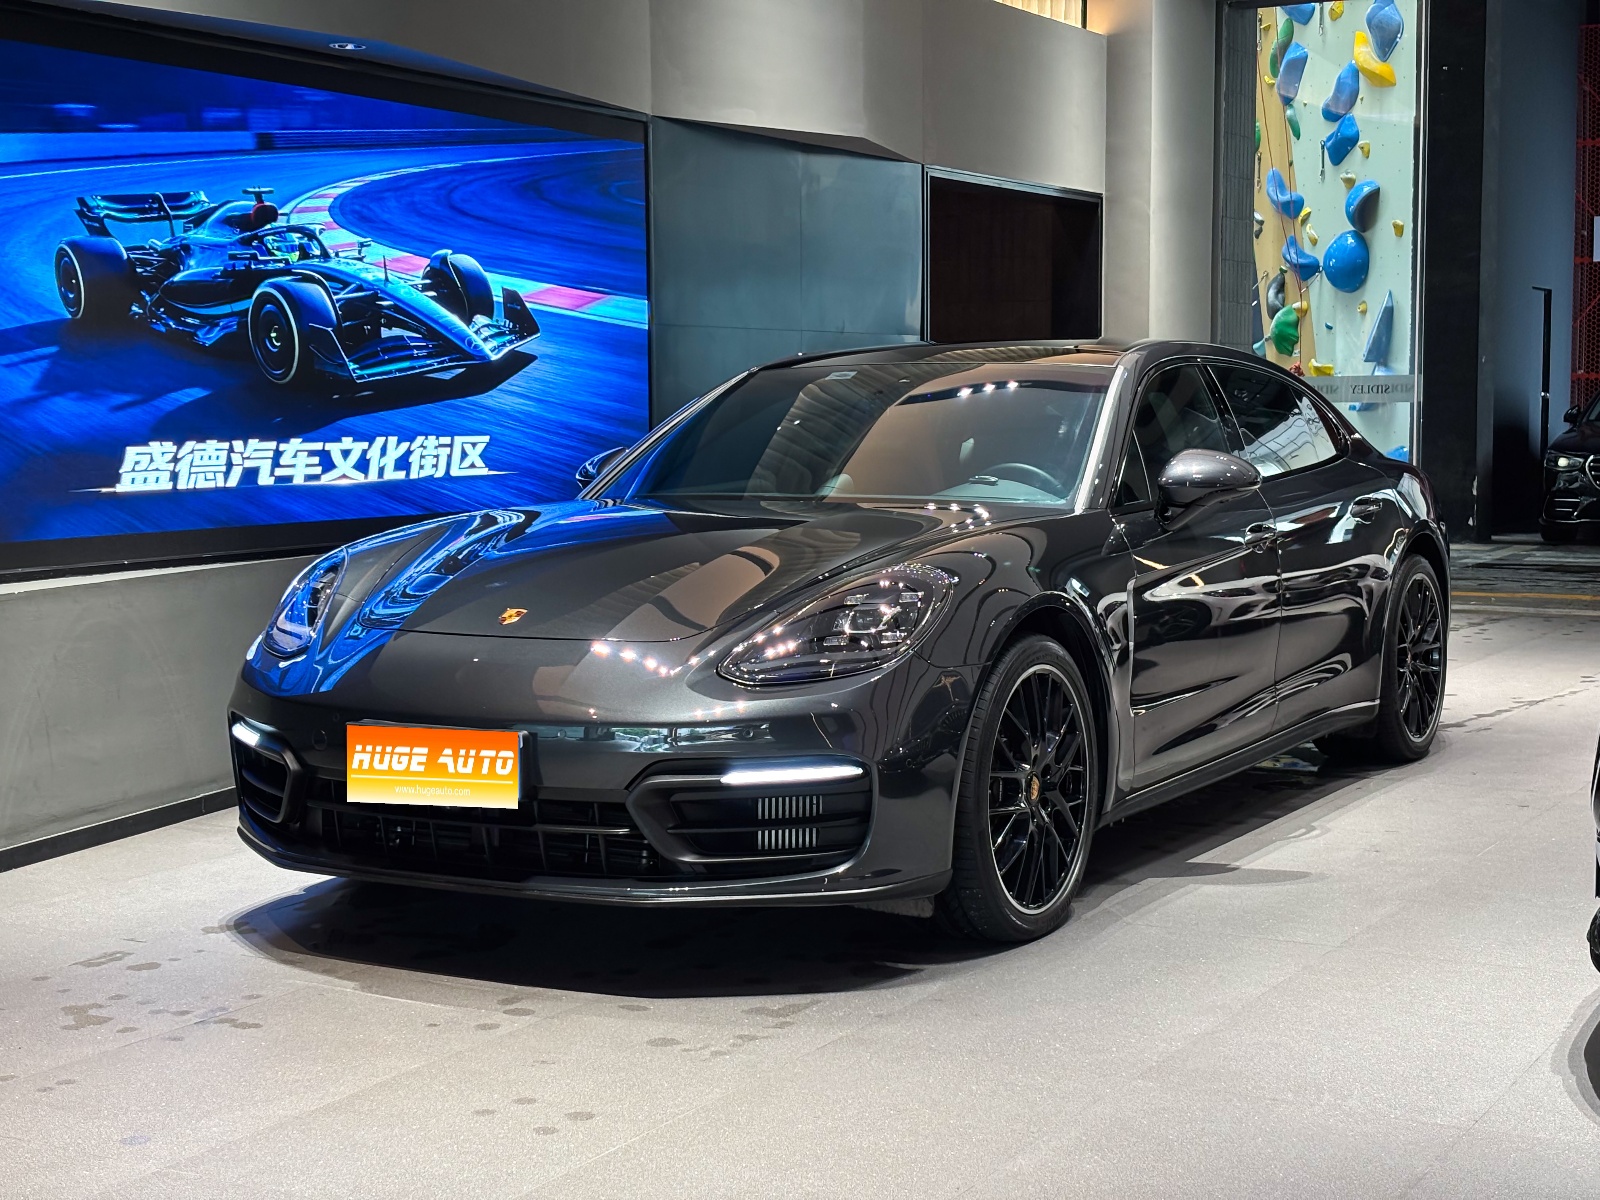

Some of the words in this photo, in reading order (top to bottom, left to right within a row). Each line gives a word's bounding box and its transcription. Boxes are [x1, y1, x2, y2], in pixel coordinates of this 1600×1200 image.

[115, 435, 491, 492] 盛德汽车文化街区
